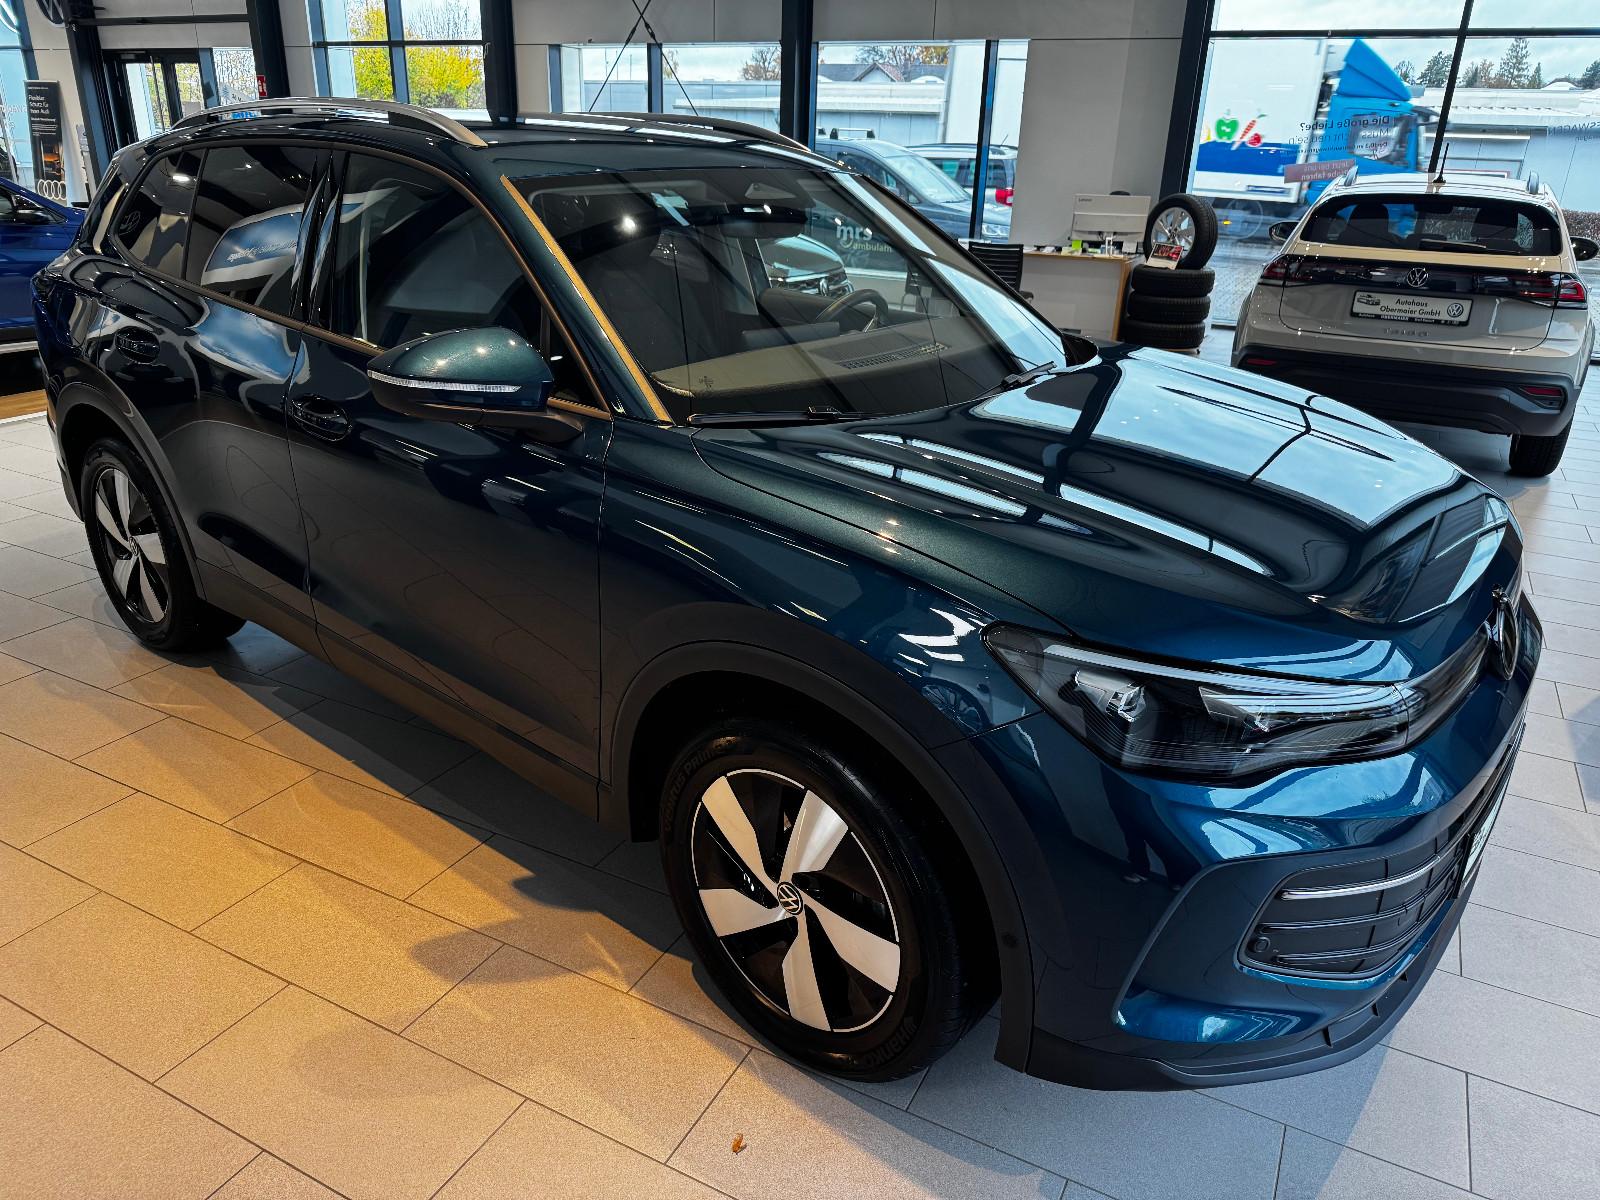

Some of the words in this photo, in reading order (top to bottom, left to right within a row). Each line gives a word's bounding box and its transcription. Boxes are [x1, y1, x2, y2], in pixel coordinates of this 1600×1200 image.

[1395, 298, 1428, 308] Autohaus
[1380, 305, 1417, 316] Obermaier
[1418, 309, 1441, 317] GmbH
